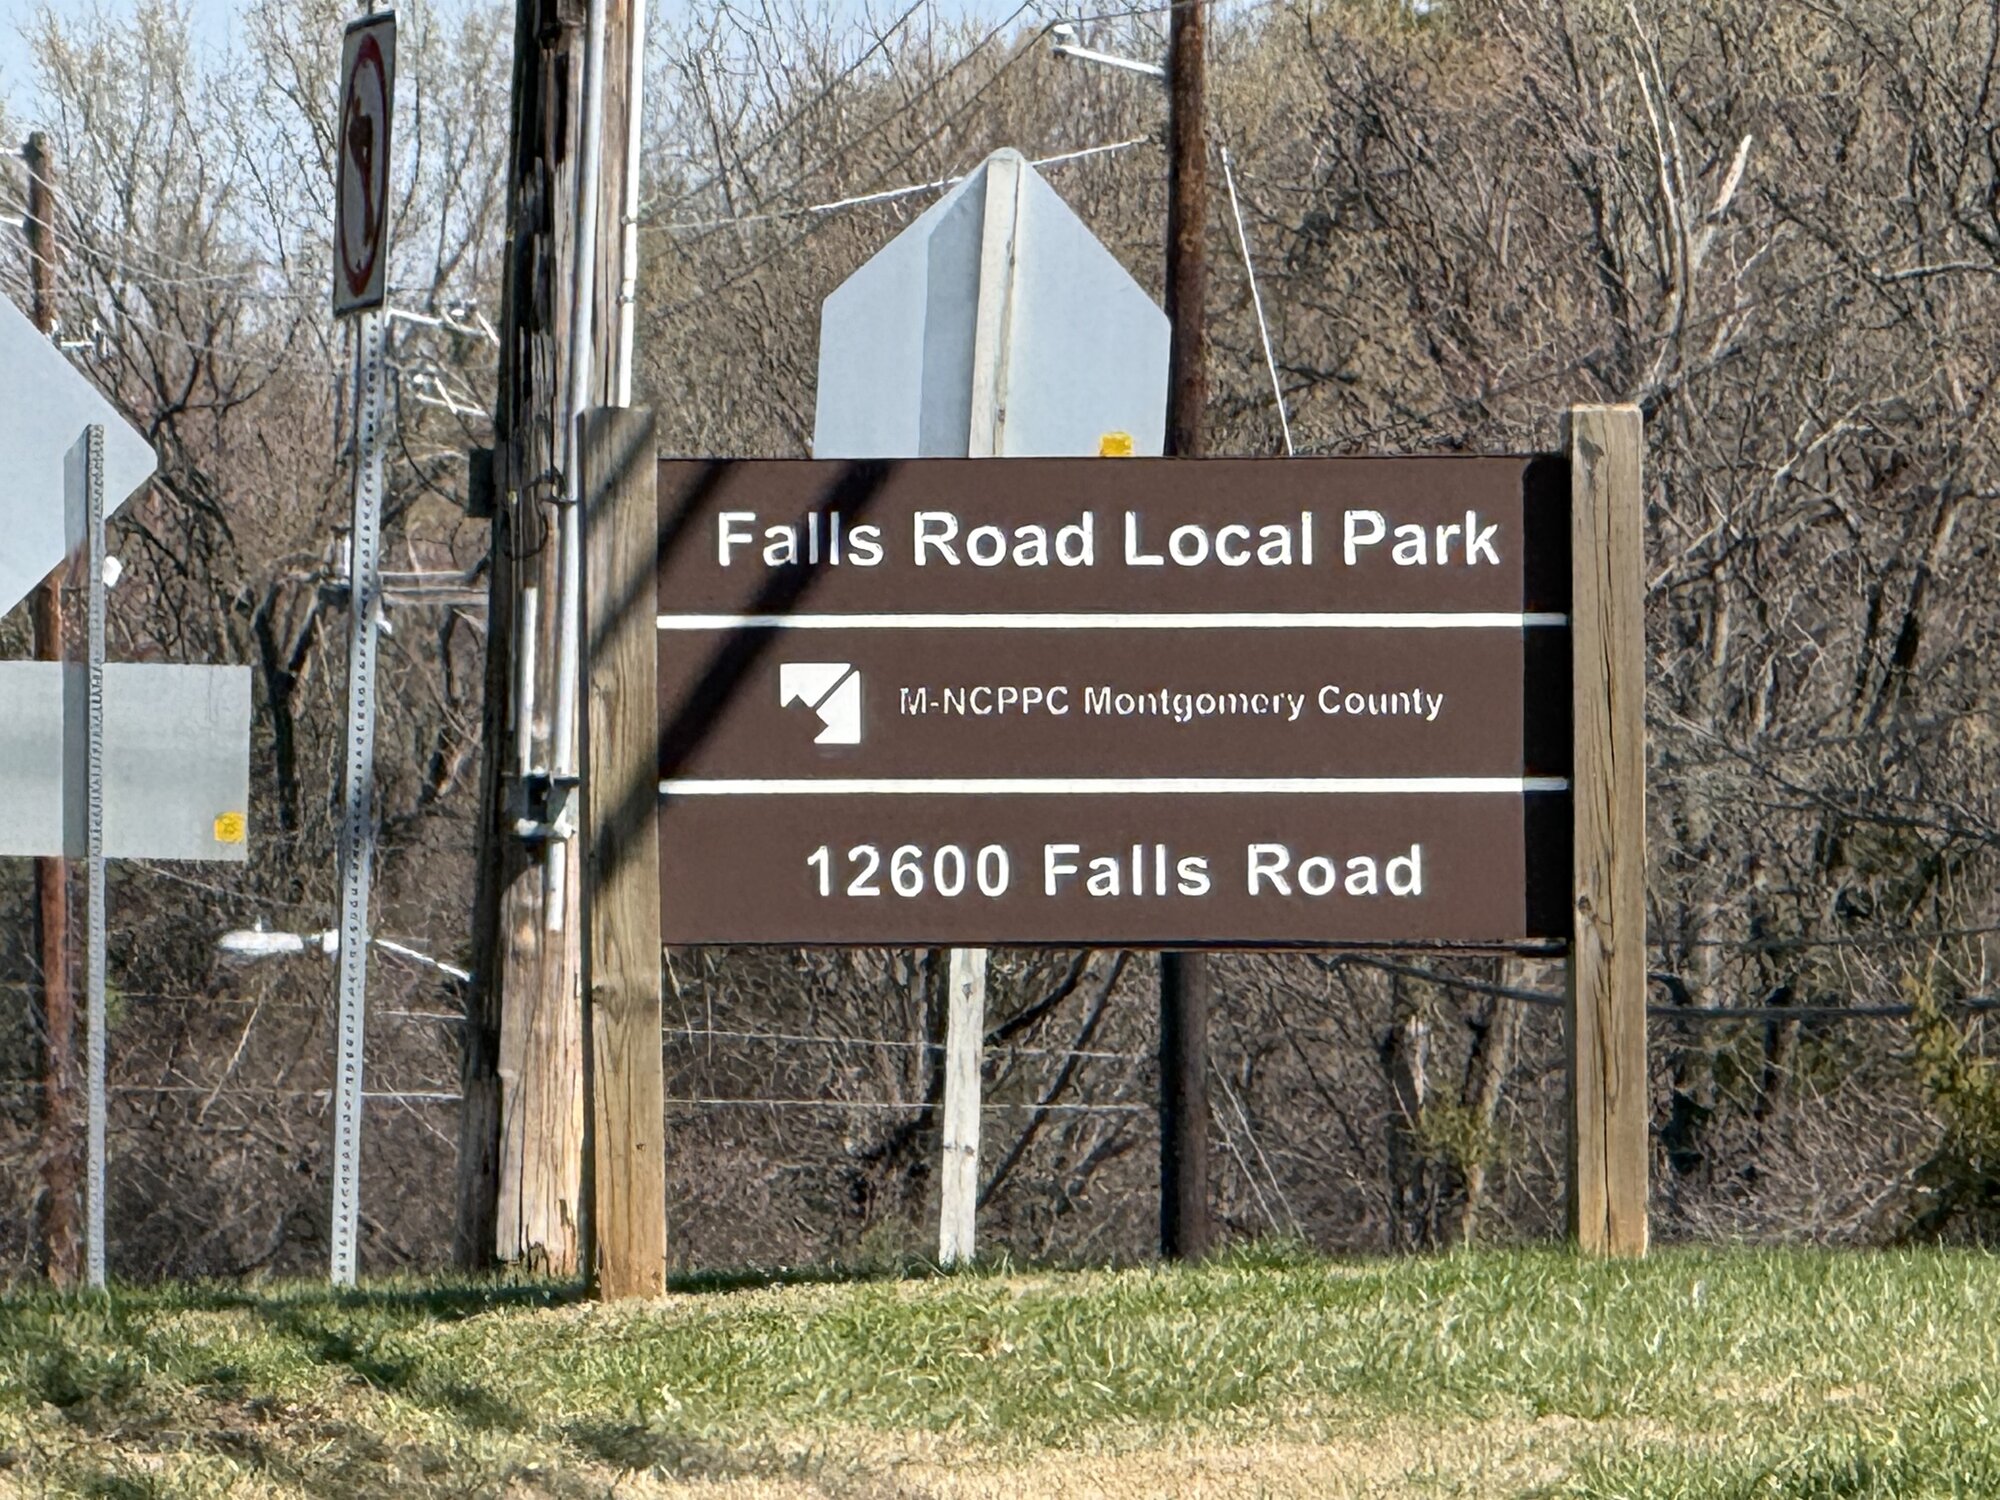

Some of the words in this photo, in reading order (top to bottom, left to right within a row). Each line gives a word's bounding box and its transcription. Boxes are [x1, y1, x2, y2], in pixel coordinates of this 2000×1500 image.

[717, 511, 884, 567] Falls
[913, 510, 1095, 567] Road
[1123, 510, 1313, 567] Local
[1343, 509, 1501, 567] Park
[899, 685, 1069, 716] M-NCPPC
[1083, 686, 1306, 723] Montgomery
[1317, 684, 1444, 722] County
[806, 844, 1010, 898] 12600
[1044, 843, 1211, 898] Falls
[1246, 843, 1423, 898] Road
